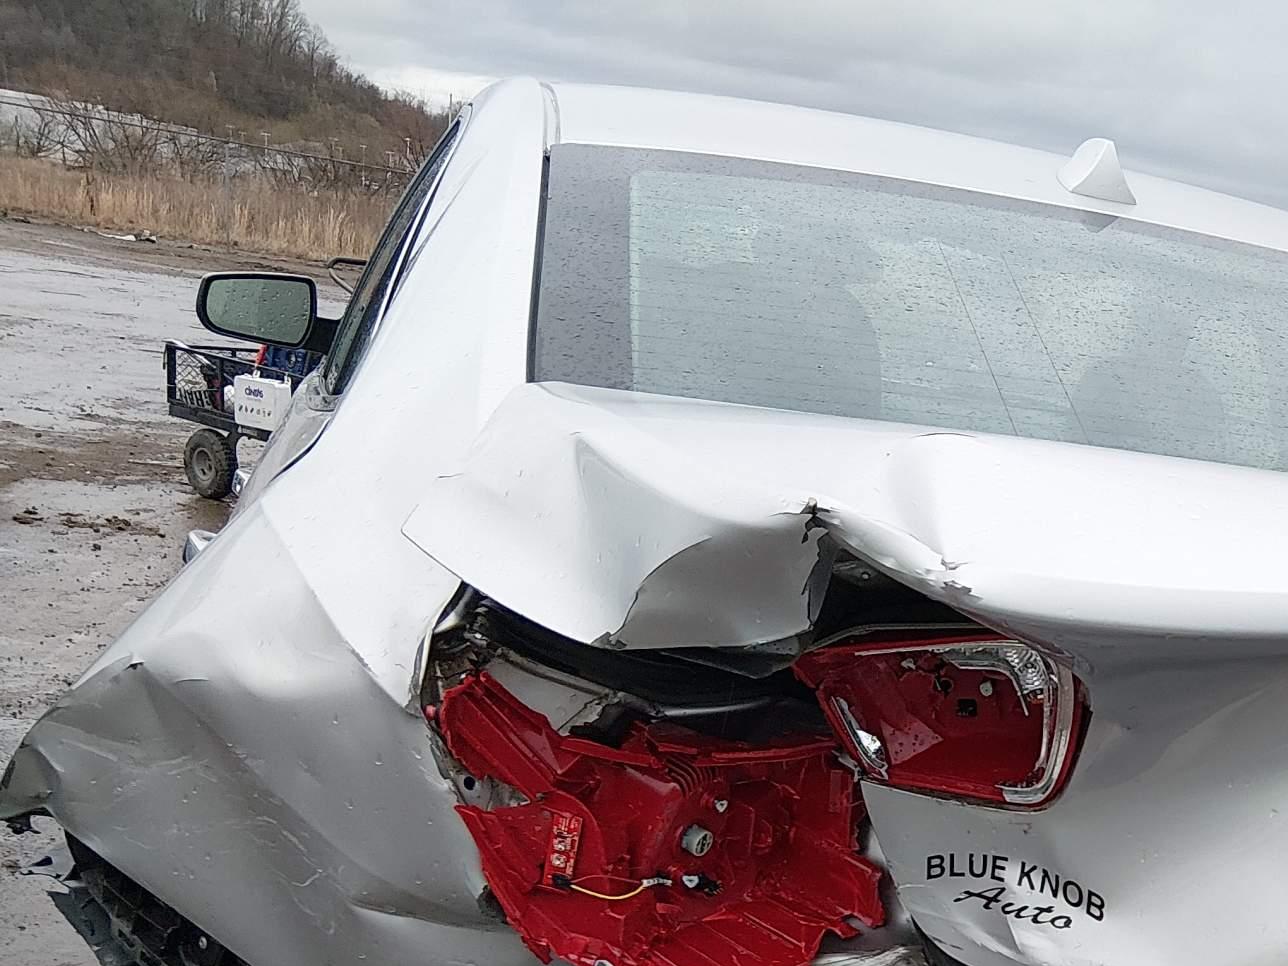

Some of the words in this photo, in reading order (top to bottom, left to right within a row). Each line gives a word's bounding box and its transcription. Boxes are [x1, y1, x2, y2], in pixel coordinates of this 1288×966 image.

[926, 853, 1009, 883] BLUE
[1017, 861, 1106, 922] KNOB
[953, 887, 1073, 930] Auto
